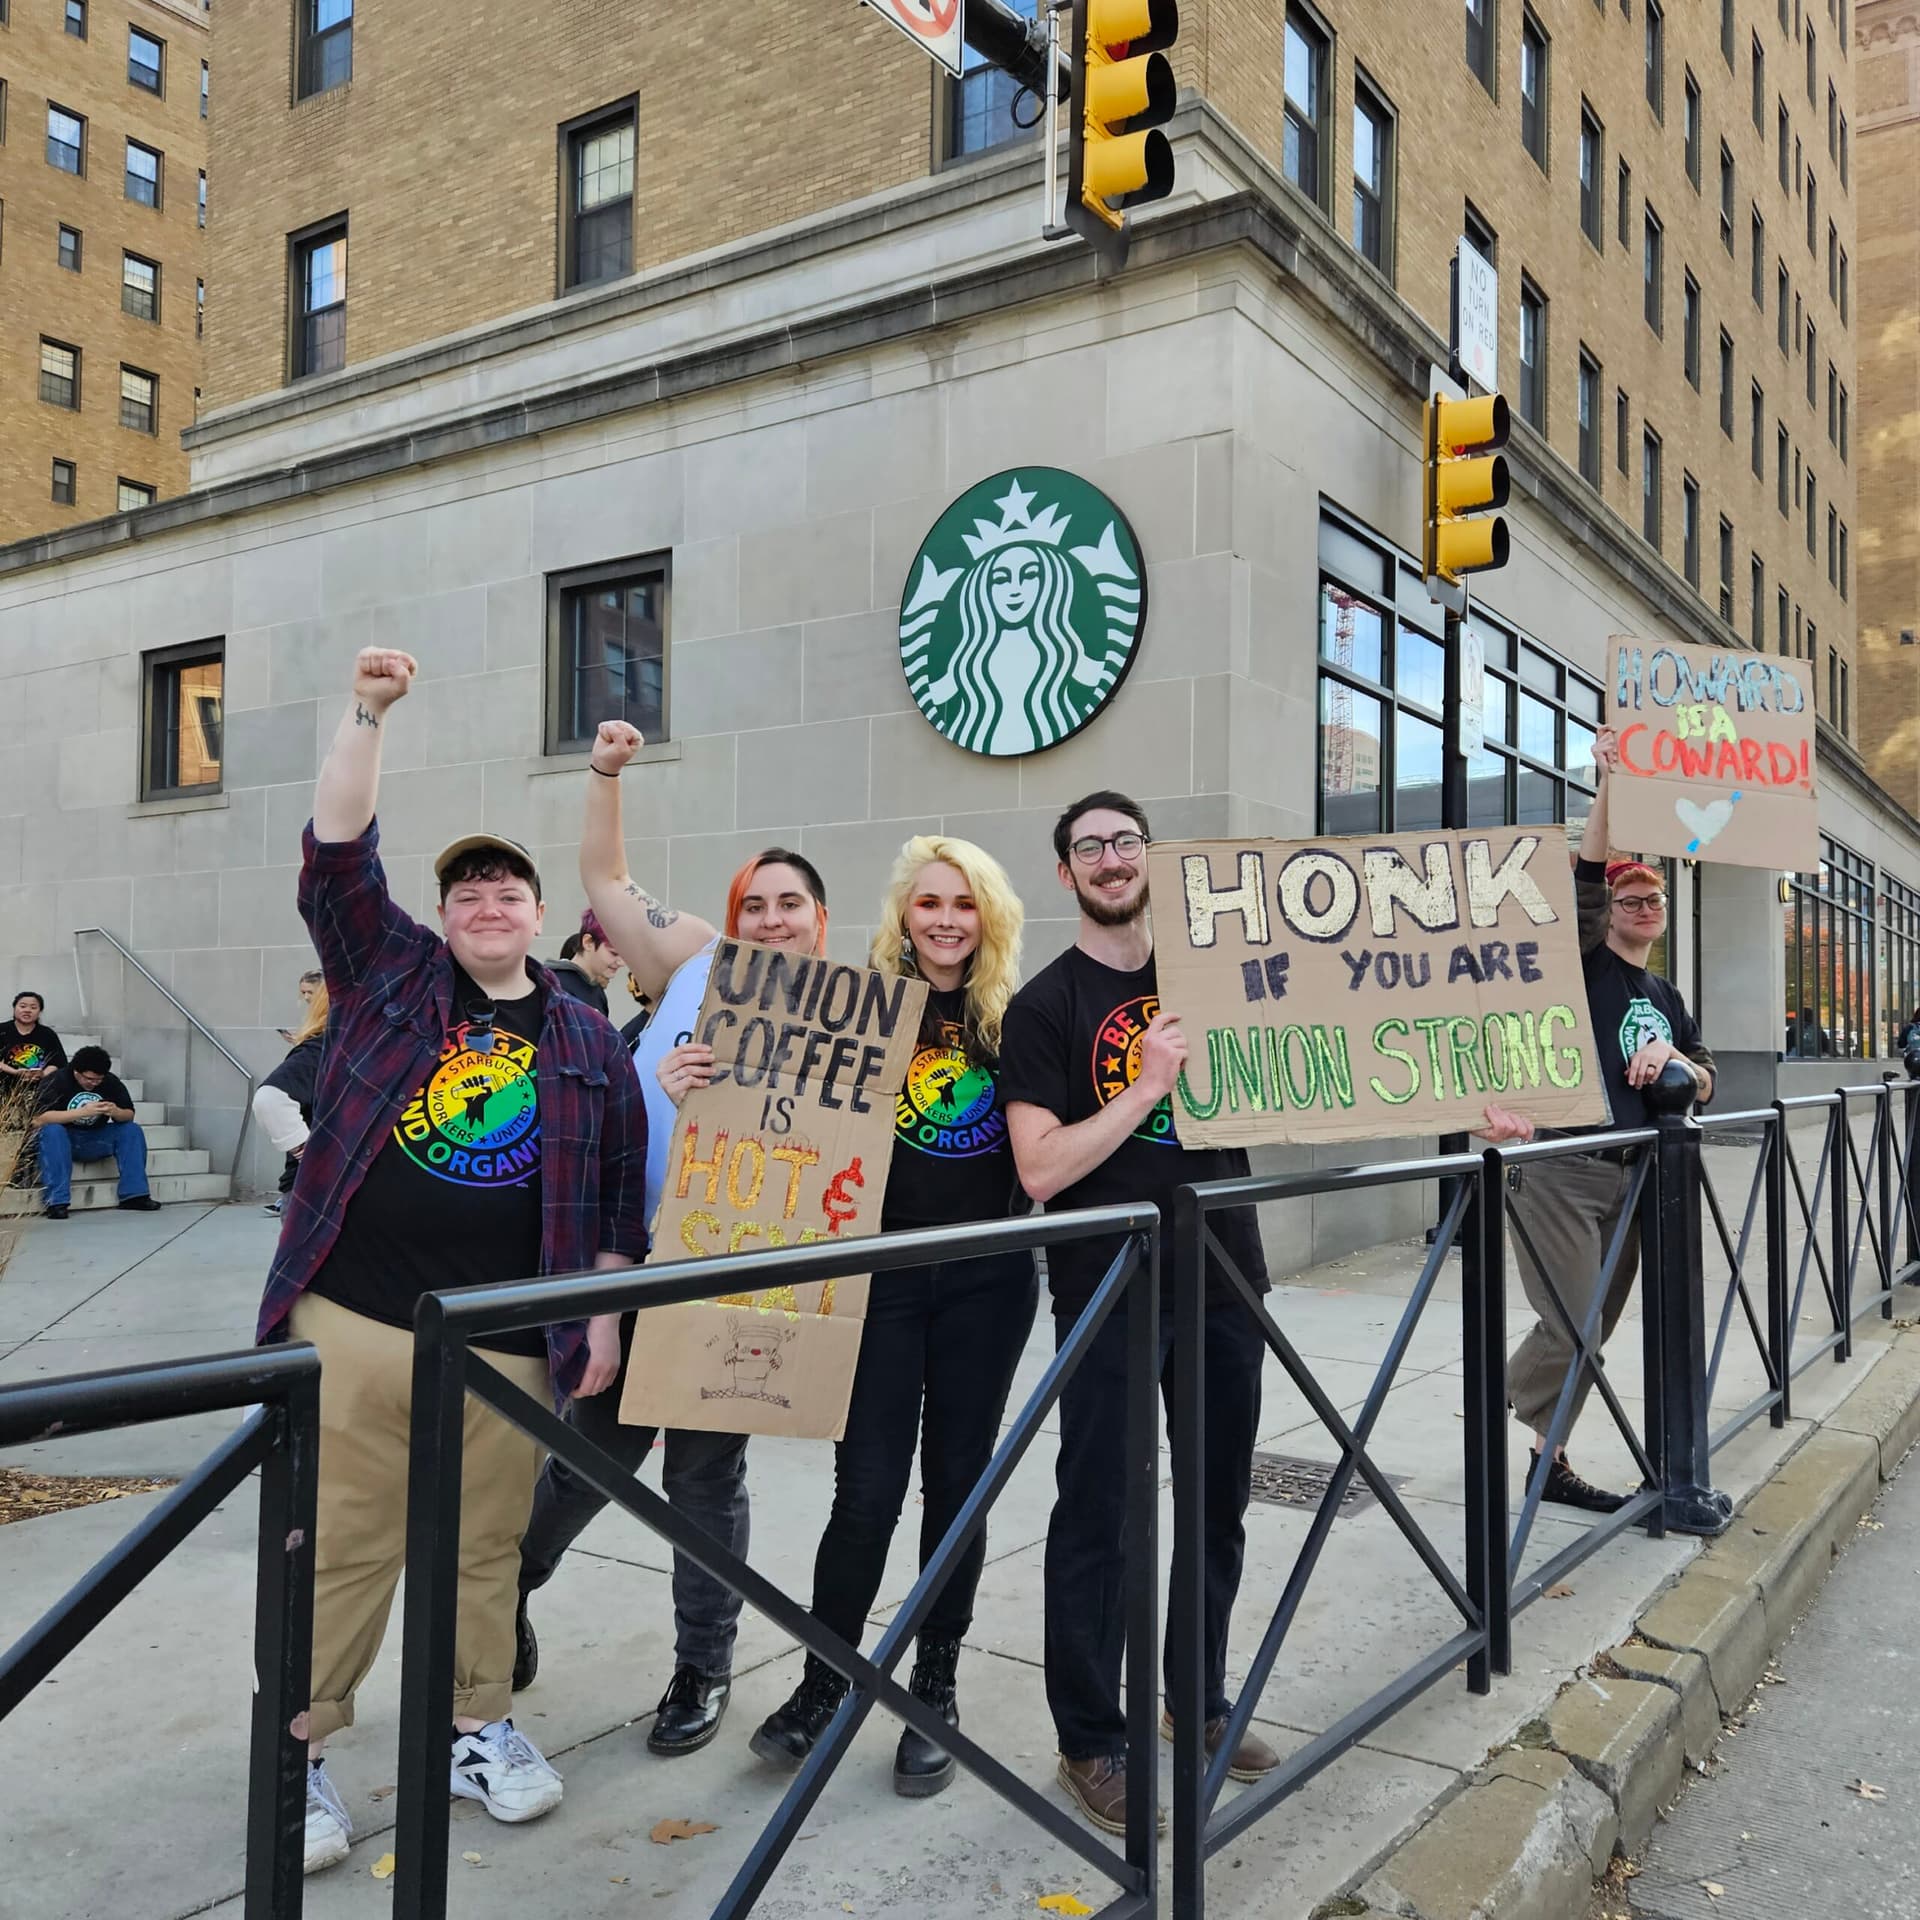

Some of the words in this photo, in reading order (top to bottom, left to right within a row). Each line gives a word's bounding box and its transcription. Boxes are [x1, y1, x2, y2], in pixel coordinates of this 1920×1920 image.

[1471, 257, 1487, 292] NO
[1468, 285, 1490, 321] TURN
[1462, 306, 1474, 334] ON
[1478, 322, 1495, 351] RED
[1617, 646, 1805, 715] HOWARD
[1676, 703, 1709, 740] IS
[1709, 704, 1737, 743] A
[1618, 722, 1812, 789] COWARD!
[1180, 836, 1559, 948] HONK
[715, 943, 908, 1038] UNION
[1240, 952, 1291, 1002] IF
[1340, 949, 1432, 991] YOU
[1447, 941, 1544, 984] ARE
[1102, 1011, 1141, 1050] BE
[449, 1056, 529, 1088] STARBUCKS
[703, 1009, 886, 1113] COFFEE
[916, 1050, 979, 1073] STARBUCS
[1177, 1024, 1356, 1120] UNION
[1369, 1004, 1583, 1105] STRONG
[433, 1089, 475, 1144] WORKERS
[491, 1105, 531, 1144] UNITED
[760, 1094, 798, 1134] IS
[895, 1093, 918, 1129] ND
[918, 1110, 1006, 1149] ORGANI
[912, 1082, 953, 1123] WORKERS
[965, 1085, 992, 1119] UNITED
[401, 1089, 431, 1141] ND
[427, 1125, 542, 1178] ORGANI
[675, 1118, 822, 1221] HOT
